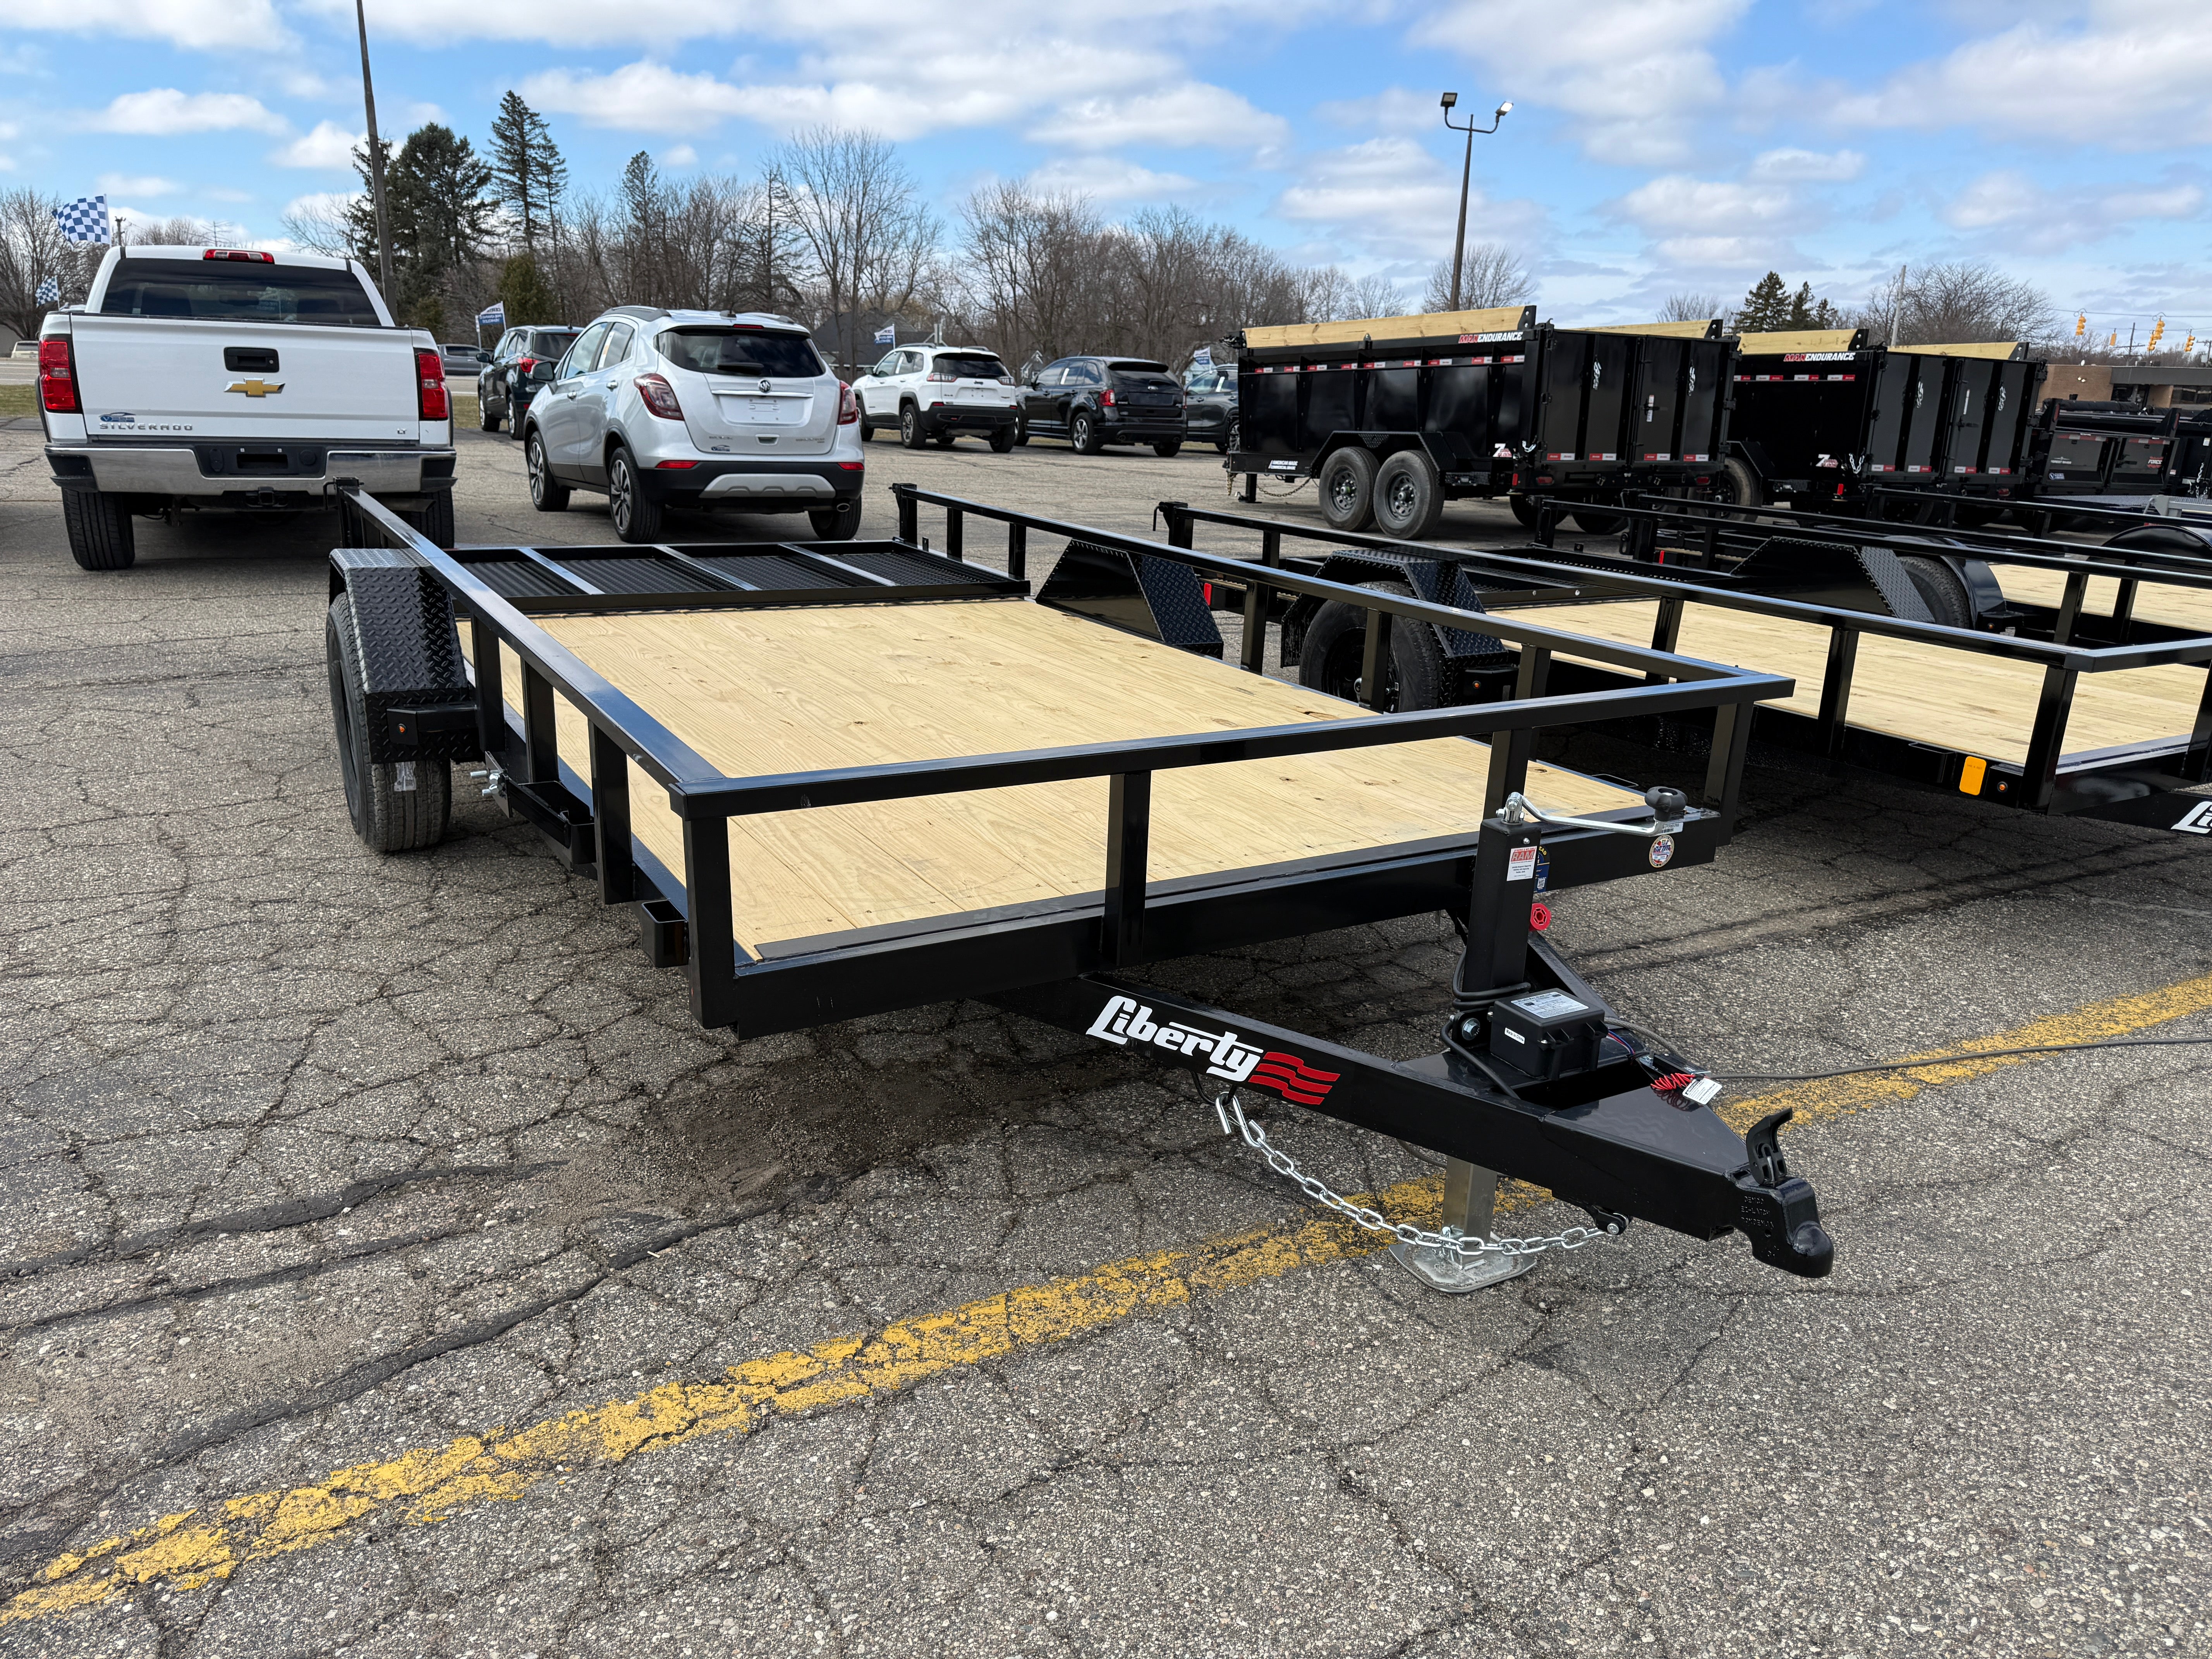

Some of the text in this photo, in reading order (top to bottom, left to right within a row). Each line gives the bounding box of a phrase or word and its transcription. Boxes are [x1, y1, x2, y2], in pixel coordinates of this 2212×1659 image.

[100, 422, 192, 431] SILVERADO
[1511, 851, 1535, 862] RAM
[1085, 995, 1264, 1082] Liberty
